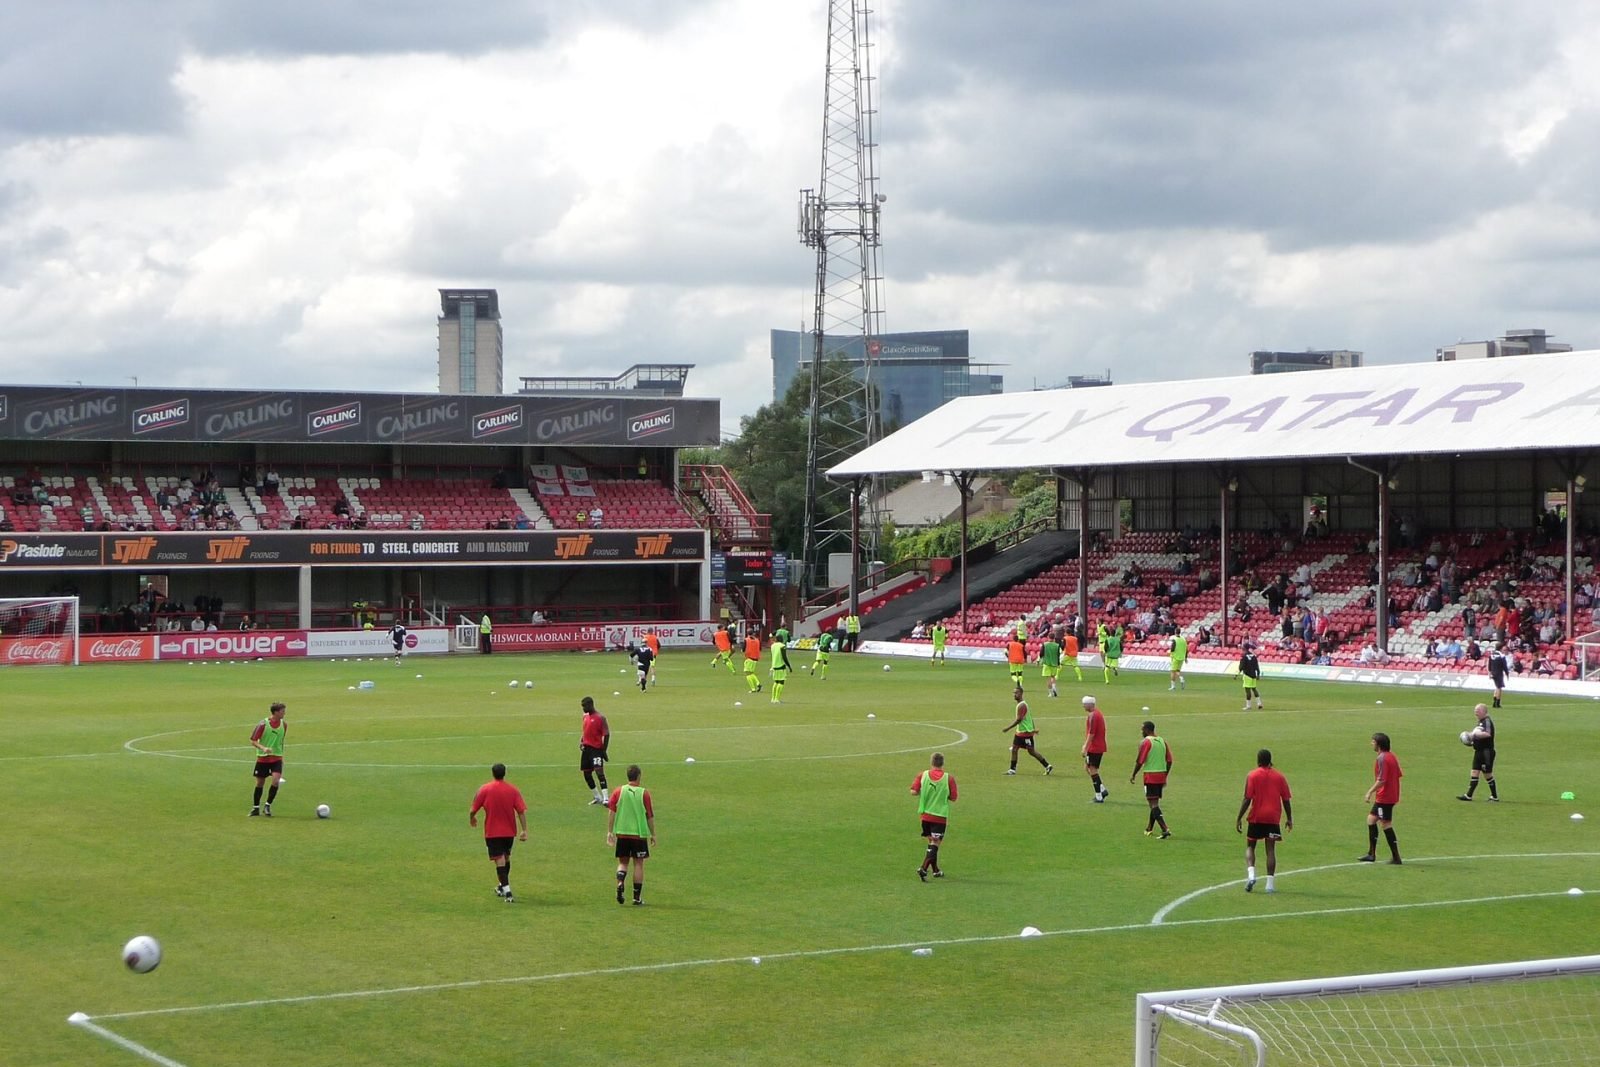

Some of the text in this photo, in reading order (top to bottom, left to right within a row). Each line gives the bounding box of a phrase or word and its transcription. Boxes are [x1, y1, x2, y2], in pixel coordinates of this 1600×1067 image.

[882, 345, 940, 354] GlaxoSmithKline
[24, 395, 117, 433] CARLING
[138, 406, 184, 427] CARLING
[205, 399, 293, 436] CARLING
[313, 408, 356, 428] CARLING
[377, 402, 458, 438] CARLING
[477, 411, 518, 431] CARLING
[537, 404, 614, 440] CARLING
[632, 414, 671, 433] CARLING
[935, 406, 1128, 448] FLY
[1126, 382, 1525, 442] QATAR
[17, 543, 64, 557] Paslode
[310, 542, 530, 555] FOR FIXING TO STEEL, CONCRETE AND MASONRY
[534, 632, 571, 642] MORAN
[632, 626, 675, 638] fisher
[90, 639, 144, 657] Coca-Cola
[182, 636, 285, 655] npower
